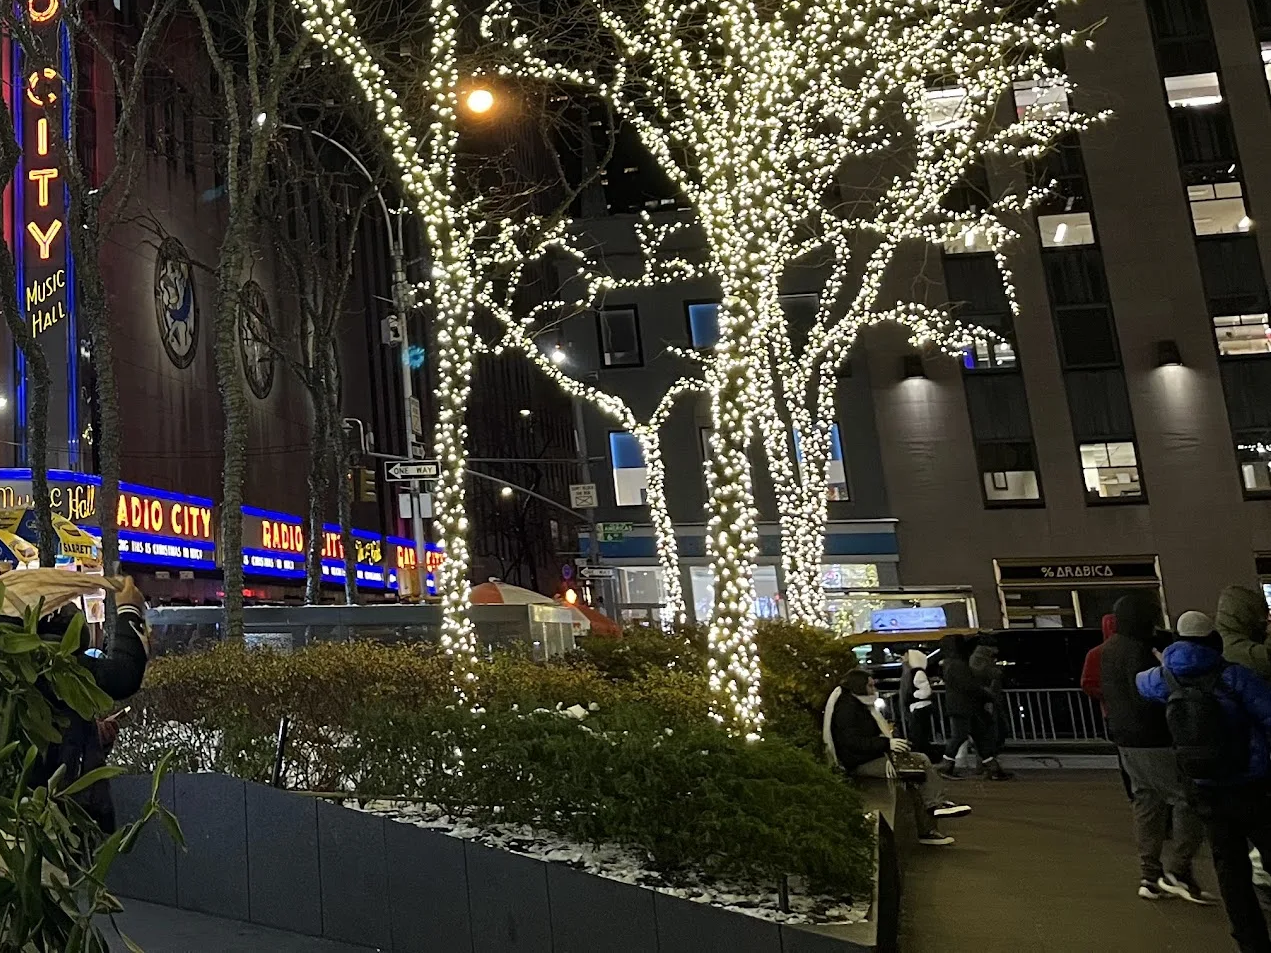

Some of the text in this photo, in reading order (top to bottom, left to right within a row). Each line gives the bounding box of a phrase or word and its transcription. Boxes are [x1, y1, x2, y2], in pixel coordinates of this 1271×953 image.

[27, 67, 62, 259] CITY
[32, 301, 65, 338] HALL
[416, 466, 433, 474] WAY
[116, 494, 211, 538] ADIO CITY
[262, 520, 304, 552] RADIO
[1056, 565, 1114, 578] ARABICA
